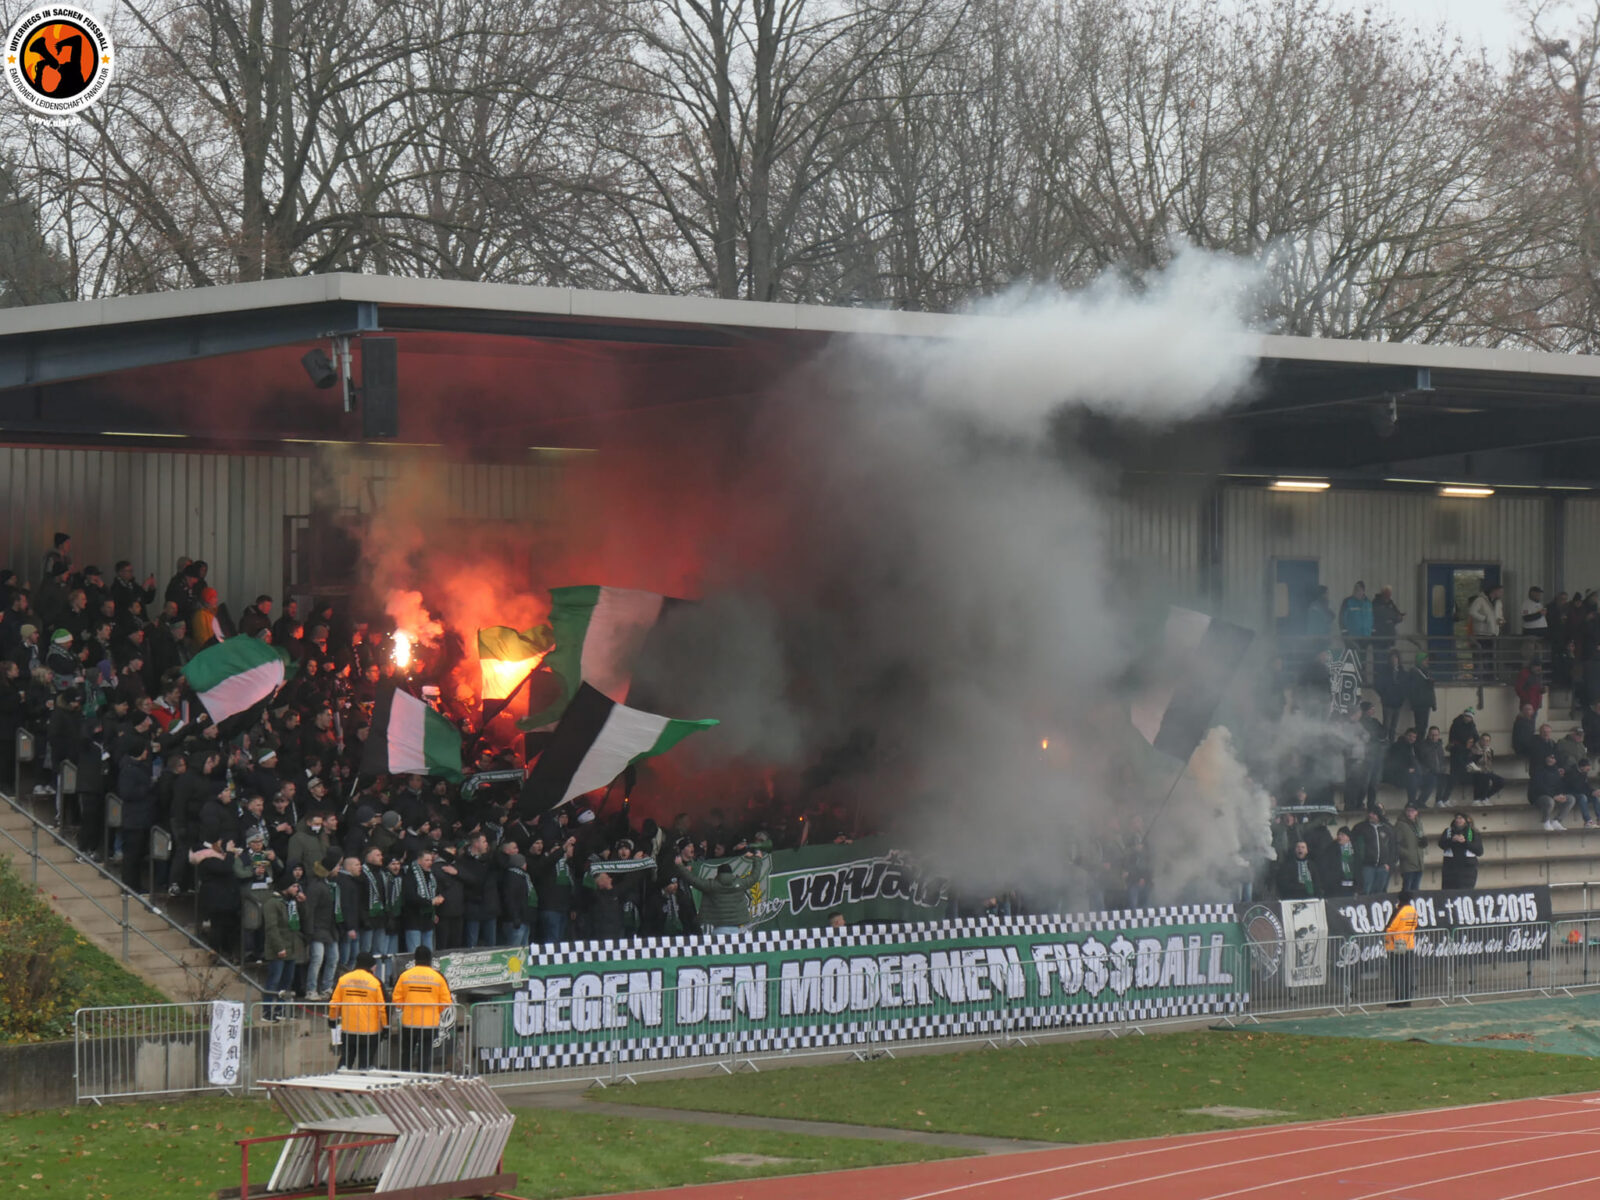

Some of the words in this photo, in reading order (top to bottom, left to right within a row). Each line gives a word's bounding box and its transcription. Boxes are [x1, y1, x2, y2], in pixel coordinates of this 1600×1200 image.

[1435, 935, 1483, 957] denken
[1485, 938, 1503, 953] an
[512, 969, 663, 1037] GEGEN
[676, 963, 768, 1026] DEN
[780, 946, 1026, 1016] MODERNEN
